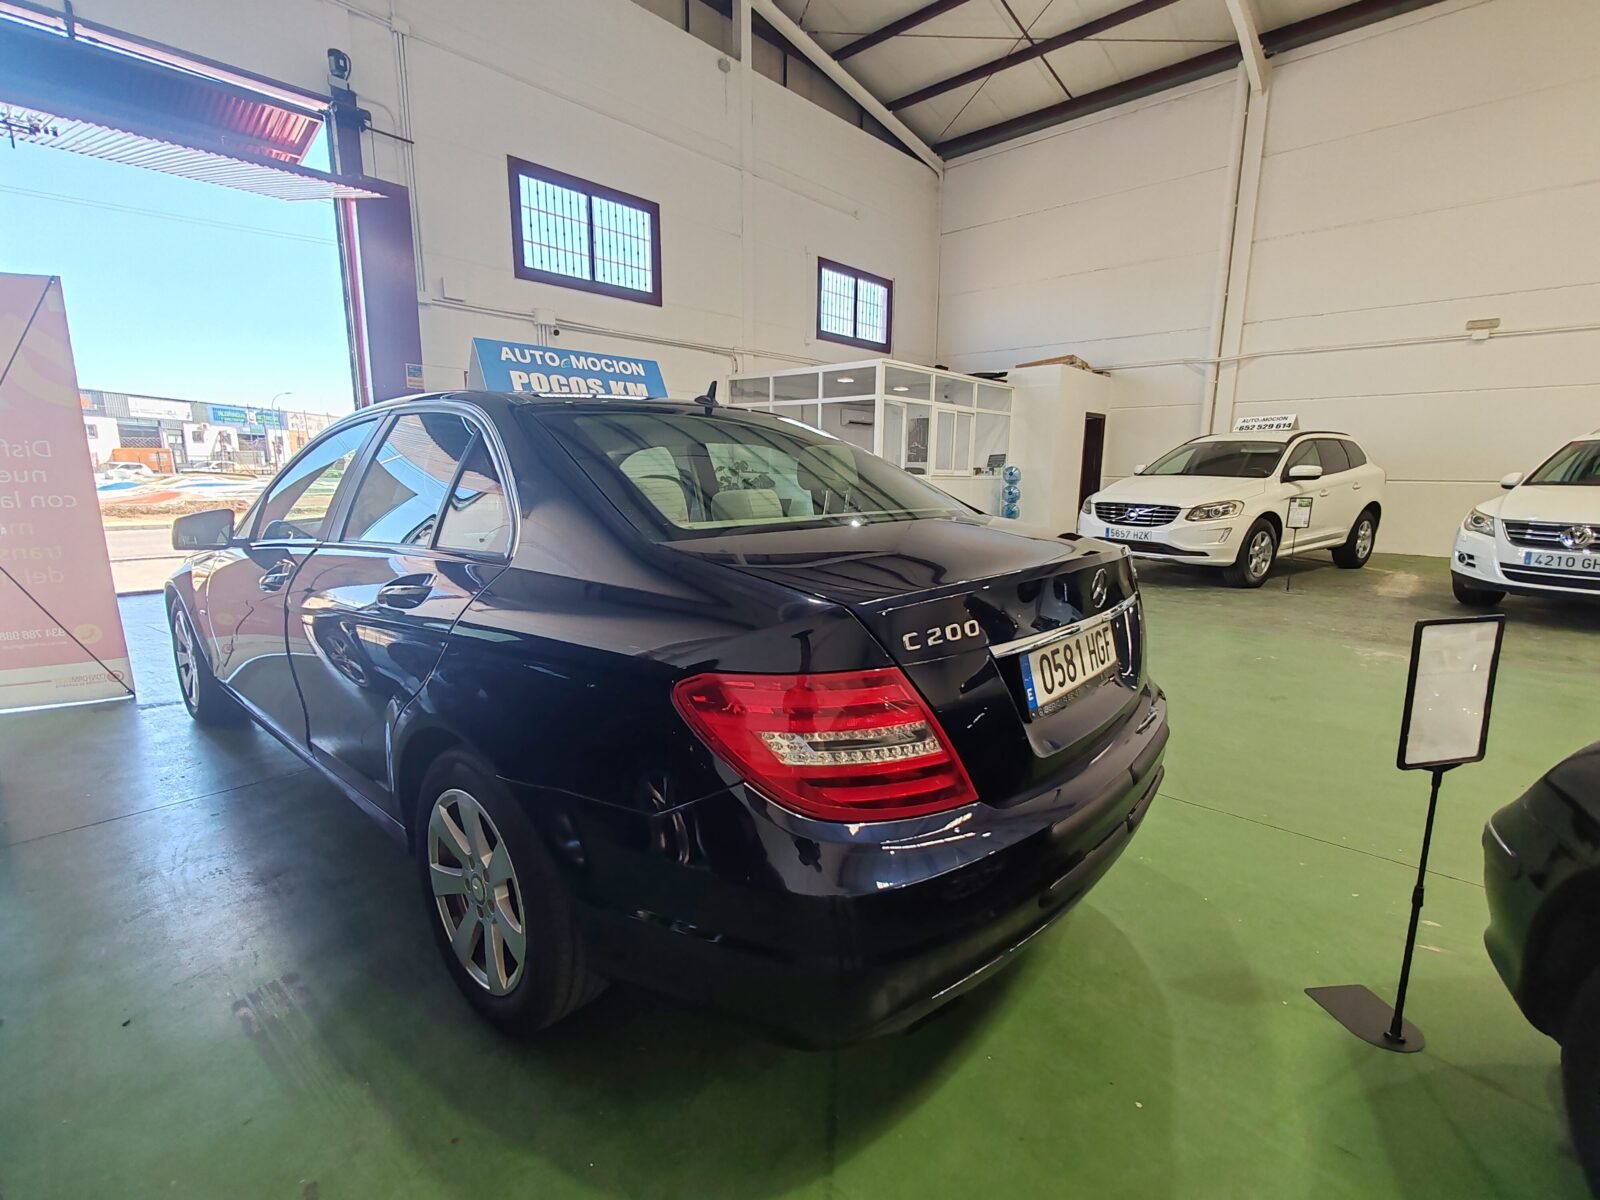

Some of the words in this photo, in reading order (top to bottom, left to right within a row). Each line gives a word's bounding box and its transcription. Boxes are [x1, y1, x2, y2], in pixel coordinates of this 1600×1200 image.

[509, 370, 606, 394] POCOS
[609, 380, 649, 397] KM
[1275, 422, 1292, 430] 614
[1110, 528, 1131, 539] 5657
[1133, 530, 1150, 541] HZK
[1534, 554, 1576, 568] 4210
[902, 632, 922, 651] C
[927, 619, 981, 647] 200
[1039, 639, 1087, 695] 0581
[1088, 626, 1112, 673] HGF
[1026, 688, 1035, 702] E
